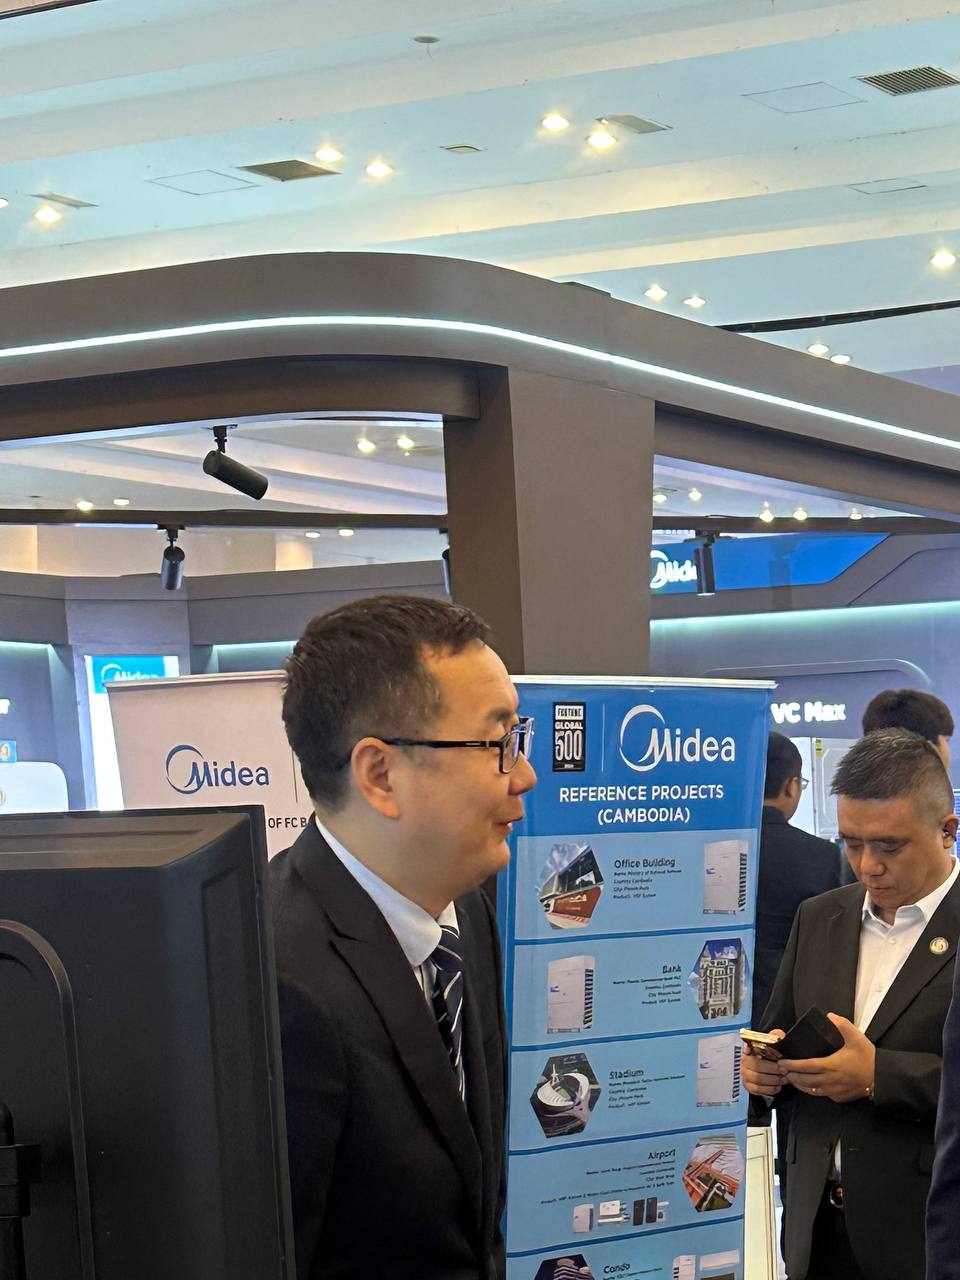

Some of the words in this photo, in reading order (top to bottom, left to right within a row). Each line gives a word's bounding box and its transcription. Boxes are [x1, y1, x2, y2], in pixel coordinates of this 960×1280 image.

[770, 703, 801, 724] VC
[804, 701, 847, 722] Max
[555, 721, 583, 730] GLOBAL
[555, 730, 582, 761] 500
[559, 786, 647, 803] REFERENCE
[651, 784, 724, 800] PROJECTS
[268, 817, 282, 829] OF
[285, 816, 298, 828] FC
[597, 807, 691, 825] (CAMBODIA)
[614, 859, 641, 869] Office
[642, 857, 676, 869] Building
[609, 1069, 645, 1080] Stadium
[647, 1149, 676, 1161] Airport
